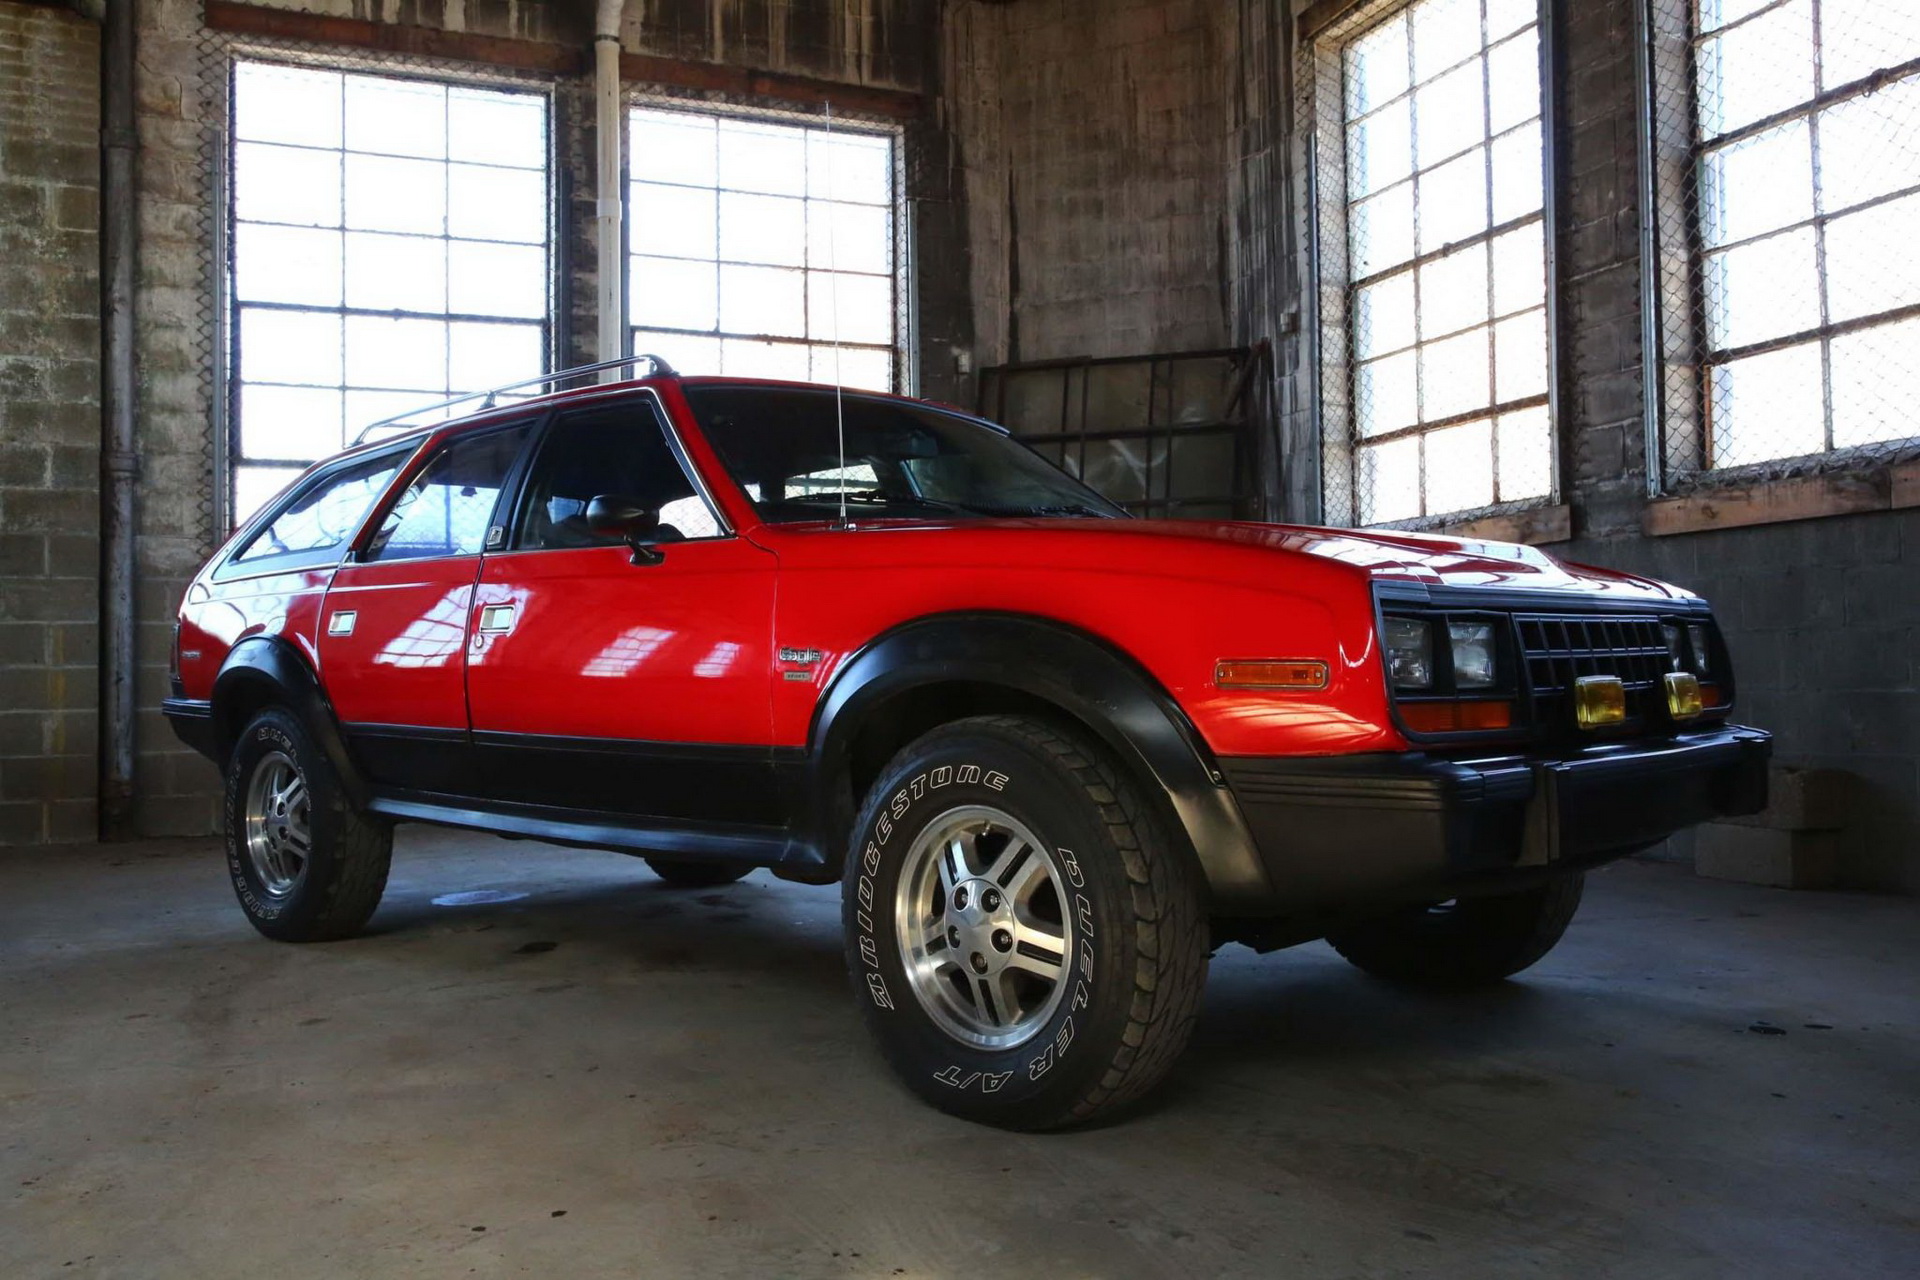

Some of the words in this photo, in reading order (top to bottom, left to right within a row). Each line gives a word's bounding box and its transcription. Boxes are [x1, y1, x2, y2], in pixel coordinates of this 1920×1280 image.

[857, 763, 1009, 1011] BRIDGESTONE
[1028, 847, 1095, 1081] DUELER
[933, 1064, 1014, 1094] A/T
